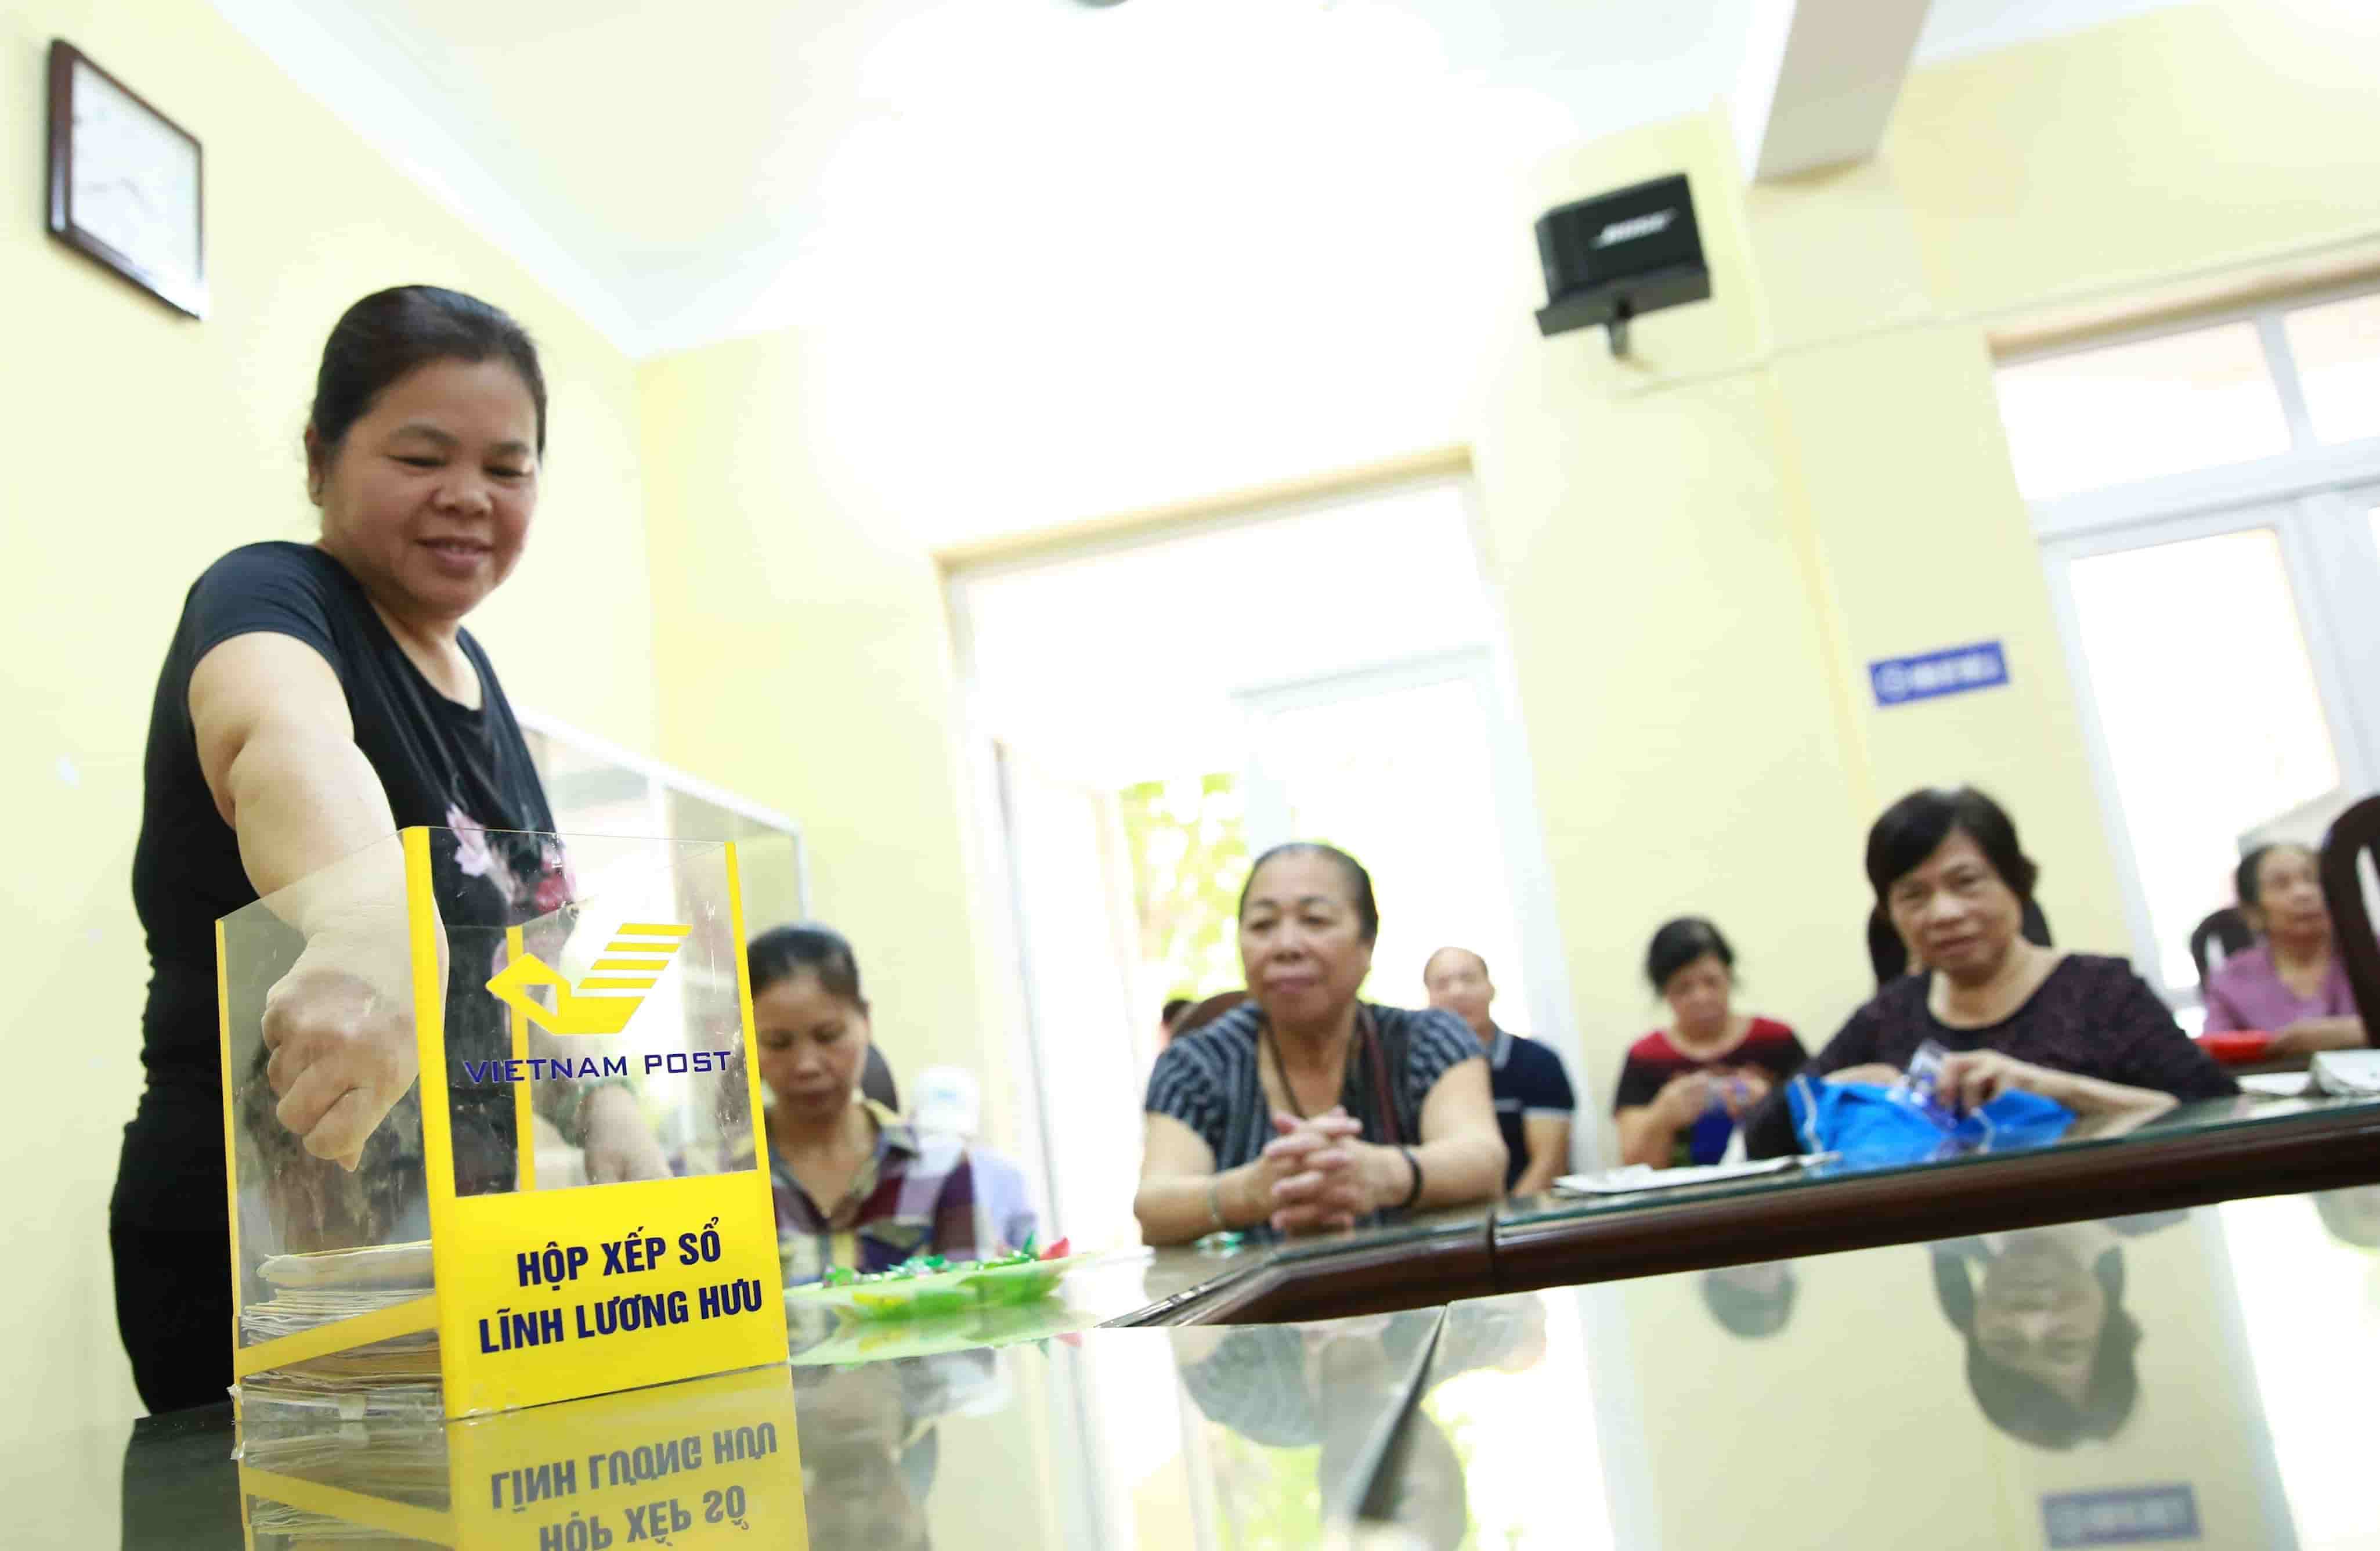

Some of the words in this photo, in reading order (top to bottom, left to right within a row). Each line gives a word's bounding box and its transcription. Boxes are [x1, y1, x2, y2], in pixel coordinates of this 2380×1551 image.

[464, 1056, 629, 1084] VIETNAM
[645, 1050, 731, 1074] POST
[517, 1240, 589, 1292] HỘP
[601, 1225, 667, 1277] XẾP
[678, 1215, 721, 1266] SỔ
[479, 1307, 565, 1354] LĨNH
[575, 1290, 689, 1340] LƯƠNG
[698, 1278, 763, 1320] HƯU
